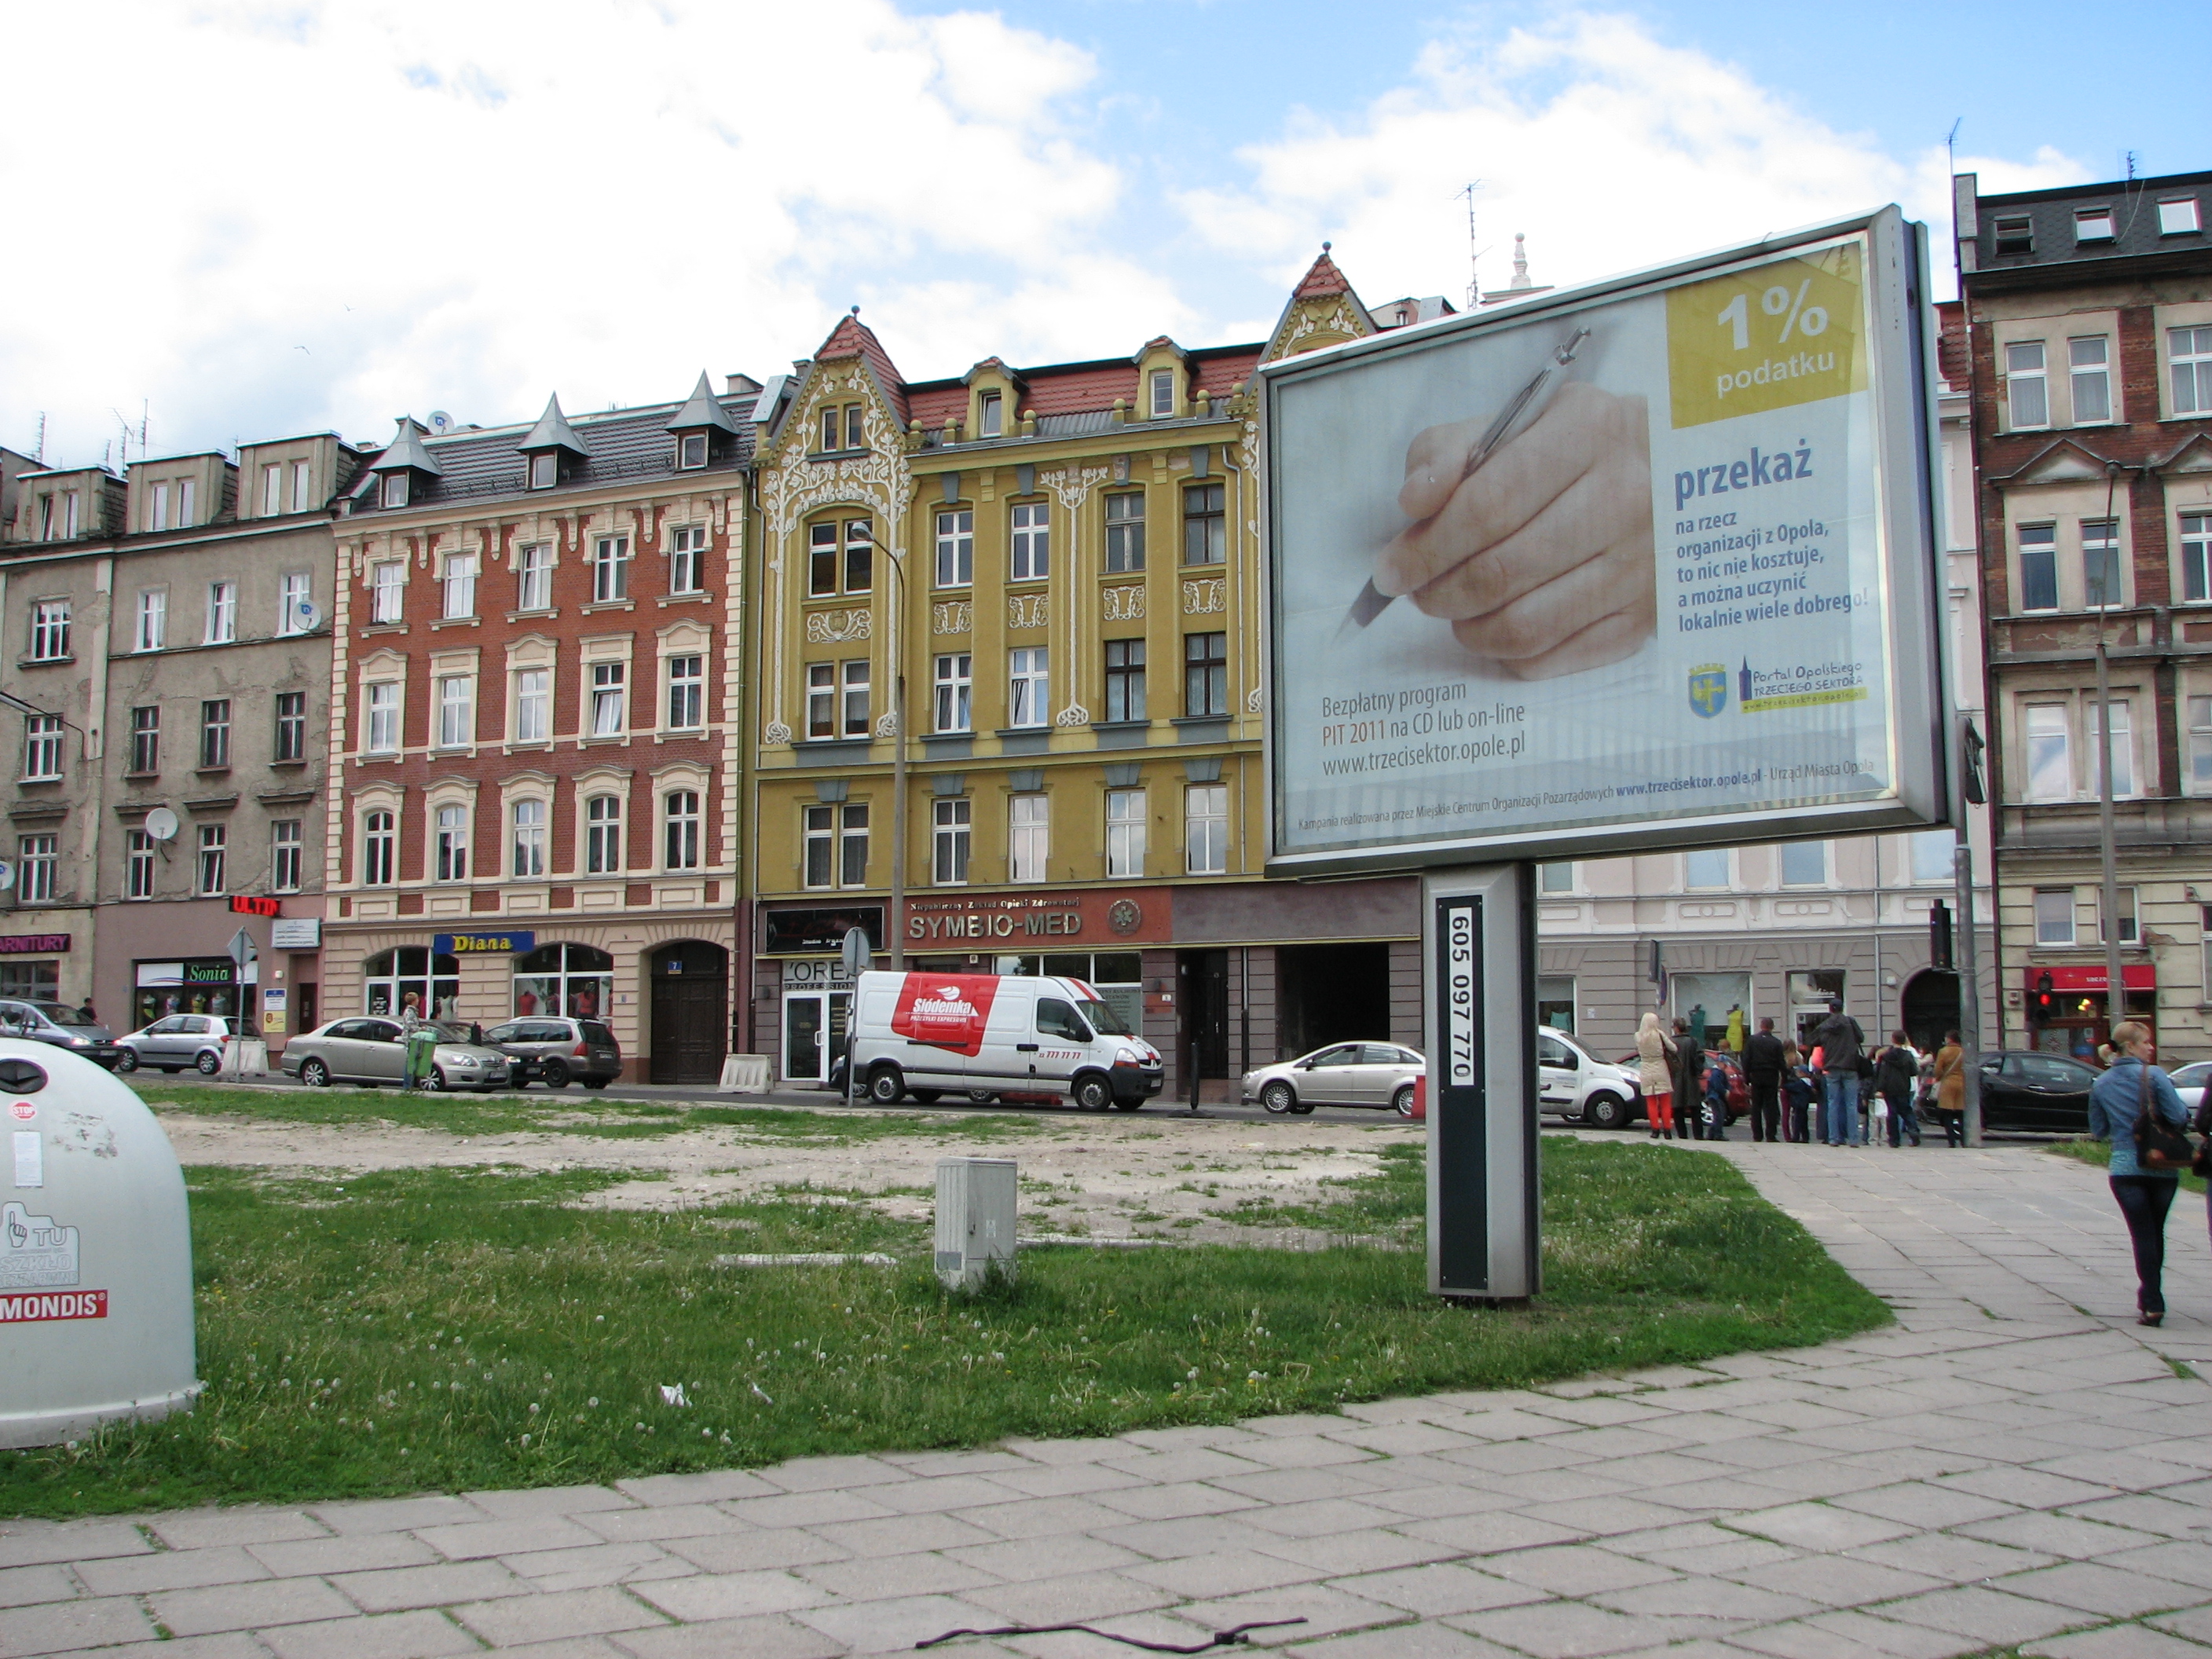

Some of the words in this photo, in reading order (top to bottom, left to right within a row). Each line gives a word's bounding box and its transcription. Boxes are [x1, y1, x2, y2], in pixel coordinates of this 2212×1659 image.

[1718, 278, 1828, 350] 1%
[1717, 351, 1833, 399] podatku
[1675, 438, 1812, 511] przekaż
[1675, 520, 1694, 535] na
[1698, 512, 1737, 531] rzecz
[1677, 528, 1760, 560] organizacji
[1766, 530, 1773, 544] z
[1777, 519, 1828, 545] Opola,
[1677, 567, 1694, 583] to
[1697, 562, 1719, 580] nic
[1723, 557, 1747, 576] nie
[1752, 545, 1824, 571] kosztuje,
[1679, 594, 1687, 607] a
[1692, 584, 1742, 606] można
[1747, 571, 1807, 598] uczynić
[1679, 607, 1742, 632] lokalnie
[1746, 599, 1789, 622] wiele
[1793, 587, 1869, 616] dobrego!
[1753, 670, 1791, 683] Portal
[1796, 661, 1862, 681] Opolskiego
[1754, 681, 1812, 697] TRZECIEGO
[1815, 675, 1863, 690] SEKTORA
[1323, 692, 1395, 720] Bezpłatny
[1399, 683, 1467, 712] program
[1323, 724, 1346, 746] PIT
[1350, 720, 1385, 744] 2011
[1390, 720, 1408, 739] na
[1413, 712, 1433, 734] CD
[1438, 709, 1463, 732] lub
[1468, 702, 1525, 728] on-line
[1323, 731, 1525, 775] www.trzecisektor.opole.pl
[1298, 815, 1339, 832] Kampania
[1341, 811, 1390, 825] realizowana
[1392, 809, 1414, 823] przez
[1416, 803, 1451, 820] Miejskie
[1453, 800, 1489, 814] Centrum
[1492, 793, 1541, 812] Organizacji
[1544, 784, 1614, 806] Pozarządowych
[1616, 767, 1761, 797] www.trzecisektor.opole.pl
[1771, 765, 1802, 782] Urząd
[1806, 761, 1840, 778] Miasta
[1843, 758, 1874, 776] Opola
[452, 935, 512, 951] Diana
[909, 911, 1082, 939] SYMBIO-MED
[1452, 916, 1470, 962] 605
[189, 964, 230, 982] Sonia
[1452, 975, 1470, 1020] 097
[1453, 1031, 1471, 1078] 770
[13, 1106, 35, 1115] STOP
[33, 1228, 68, 1247] TU
